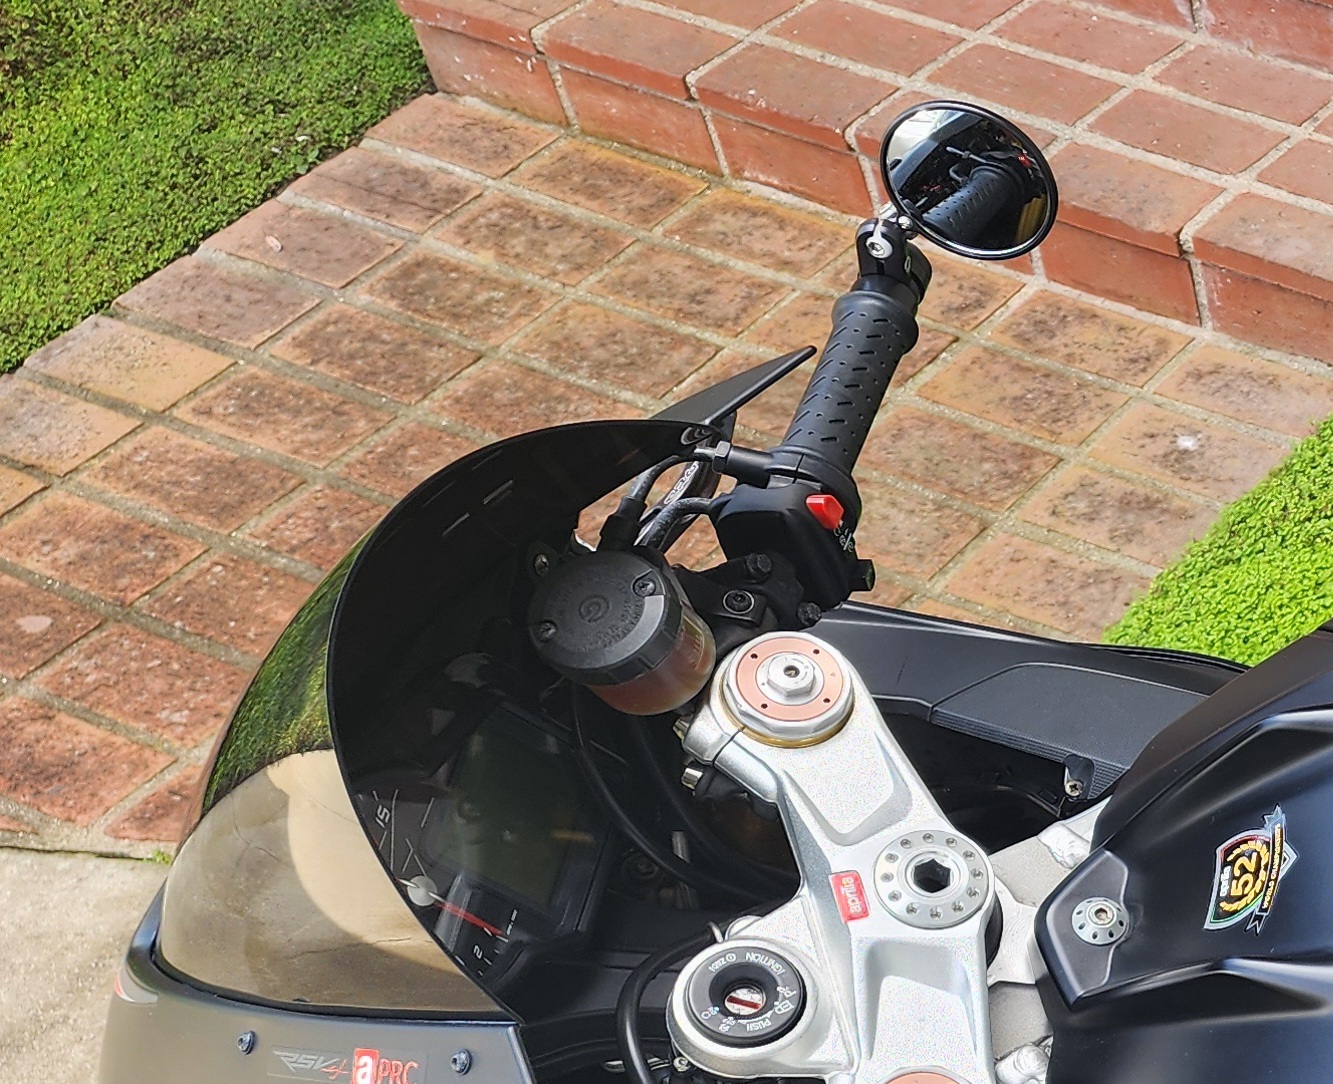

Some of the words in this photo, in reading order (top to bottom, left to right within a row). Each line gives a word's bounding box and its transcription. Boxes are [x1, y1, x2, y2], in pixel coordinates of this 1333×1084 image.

[375, 804, 390, 828] 15
[1230, 852, 1258, 896] 52
[840, 876, 863, 914] aprilia
[473, 944, 483, 959] 2
[745, 952, 786, 976] IGNITION
[746, 1018, 772, 1032] PUSH
[272, 1050, 349, 1081] RSV4
